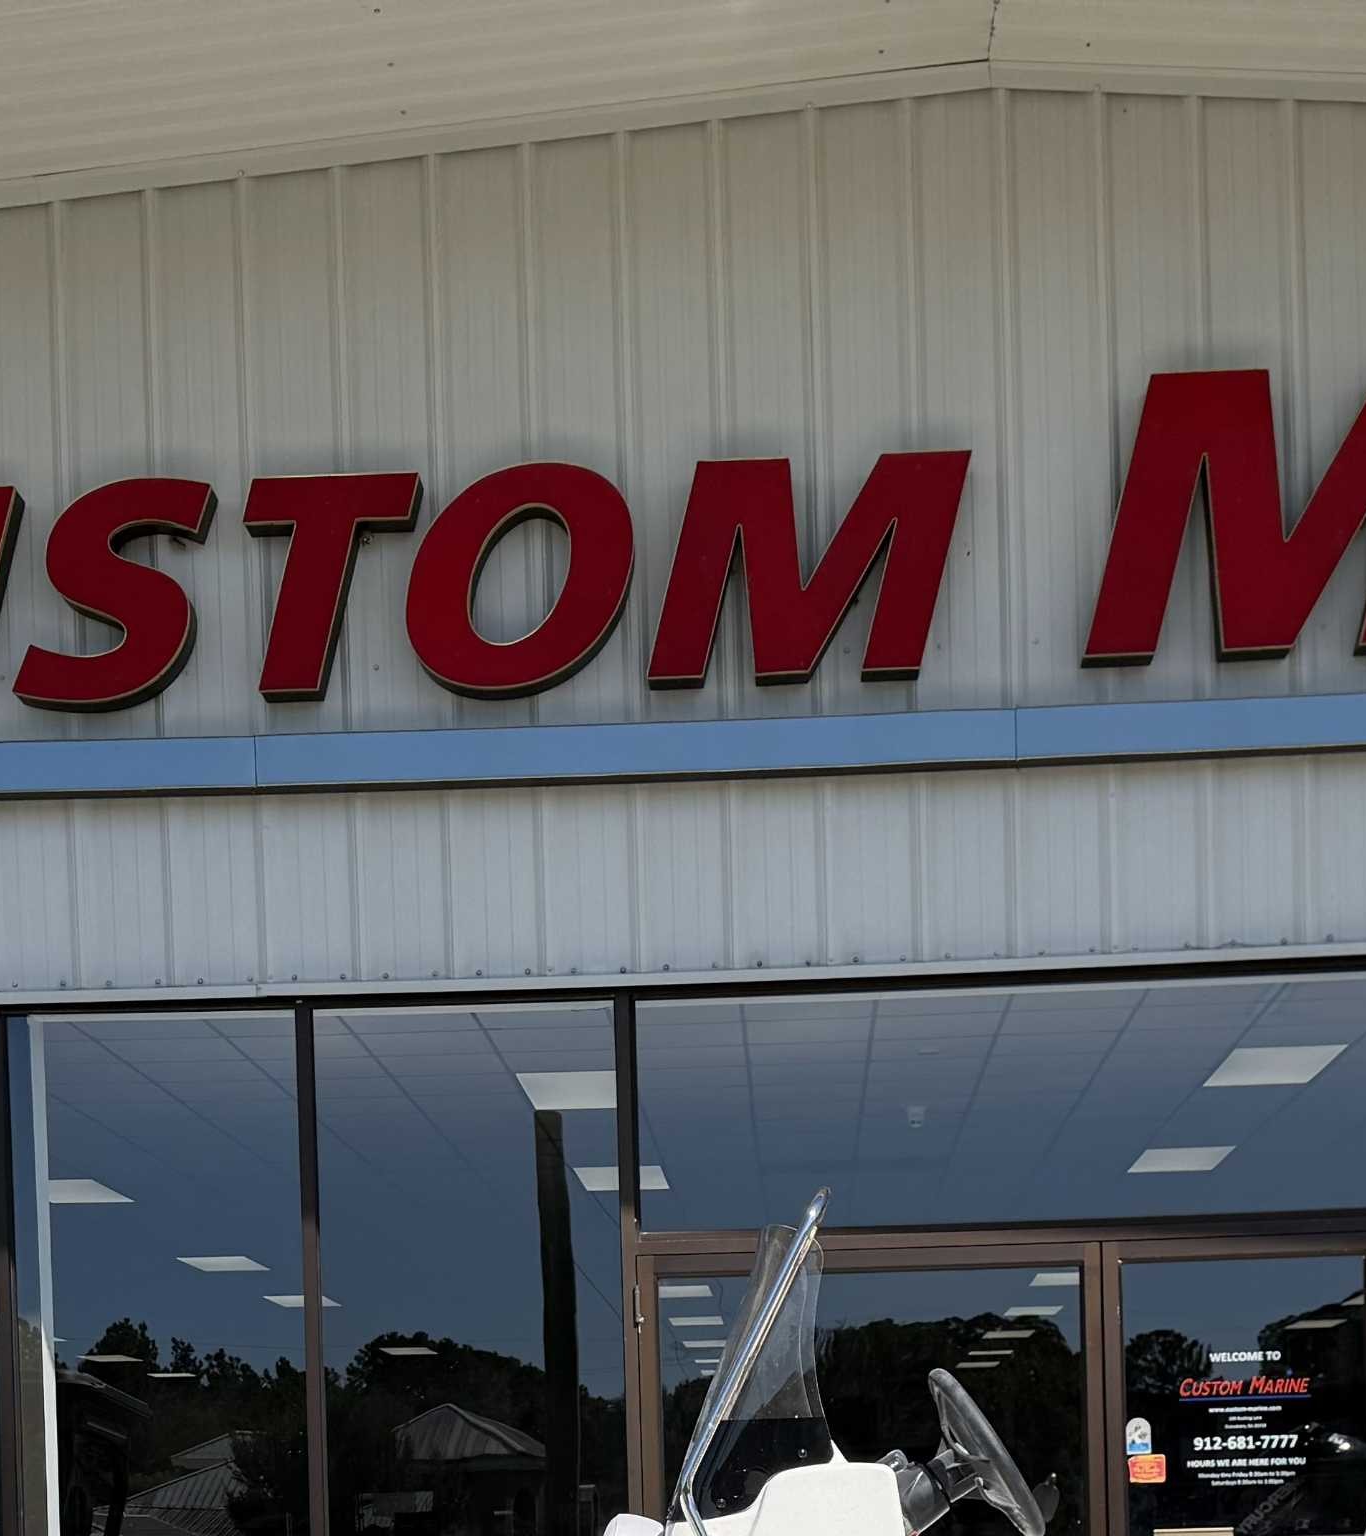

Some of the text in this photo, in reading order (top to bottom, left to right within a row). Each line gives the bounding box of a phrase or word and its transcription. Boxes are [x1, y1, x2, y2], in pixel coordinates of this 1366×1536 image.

[1209, 1350, 1282, 1363] WELCOME TO
[1179, 1376, 1310, 1397] CUSTOM MARINE
[1193, 1434, 1298, 1451] 912-681-7777
[1187, 1456, 1306, 1468] HOURS WE ARE HERE FOR YOU
